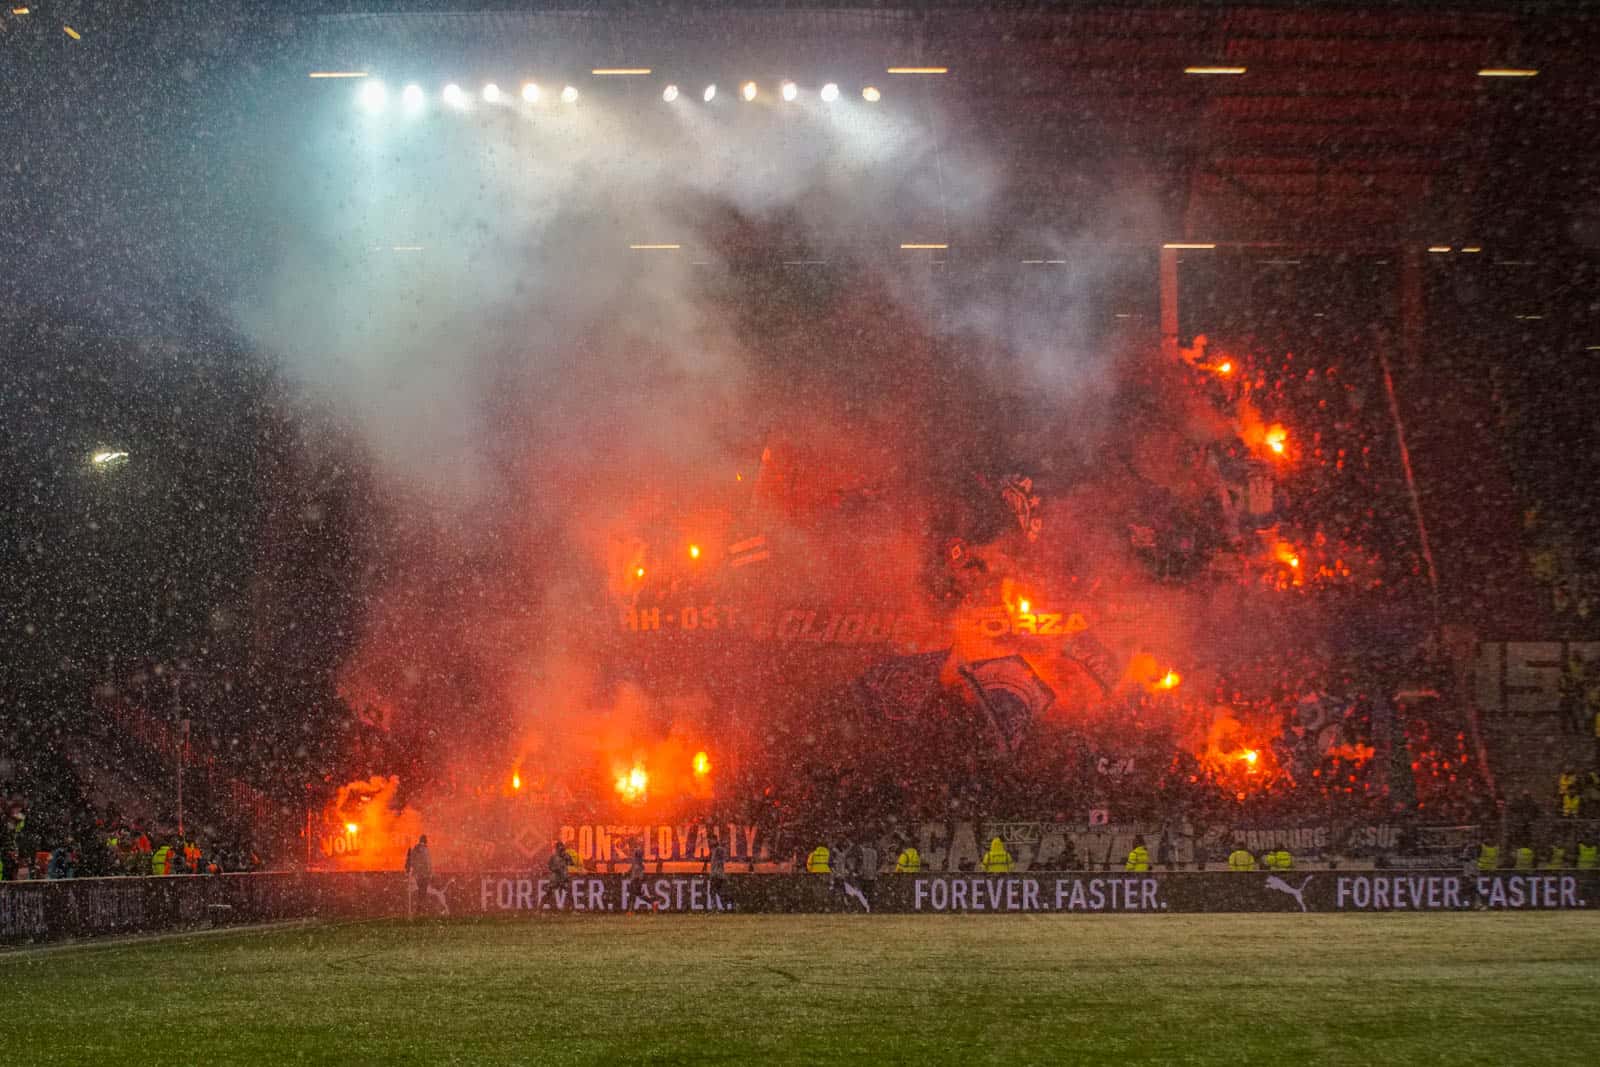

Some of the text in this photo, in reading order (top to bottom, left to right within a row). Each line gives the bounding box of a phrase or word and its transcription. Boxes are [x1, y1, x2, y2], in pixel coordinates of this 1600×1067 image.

[914, 878, 1168, 911] FOREVER. FASTER.
[1337, 876, 1470, 908] FOREVER.
